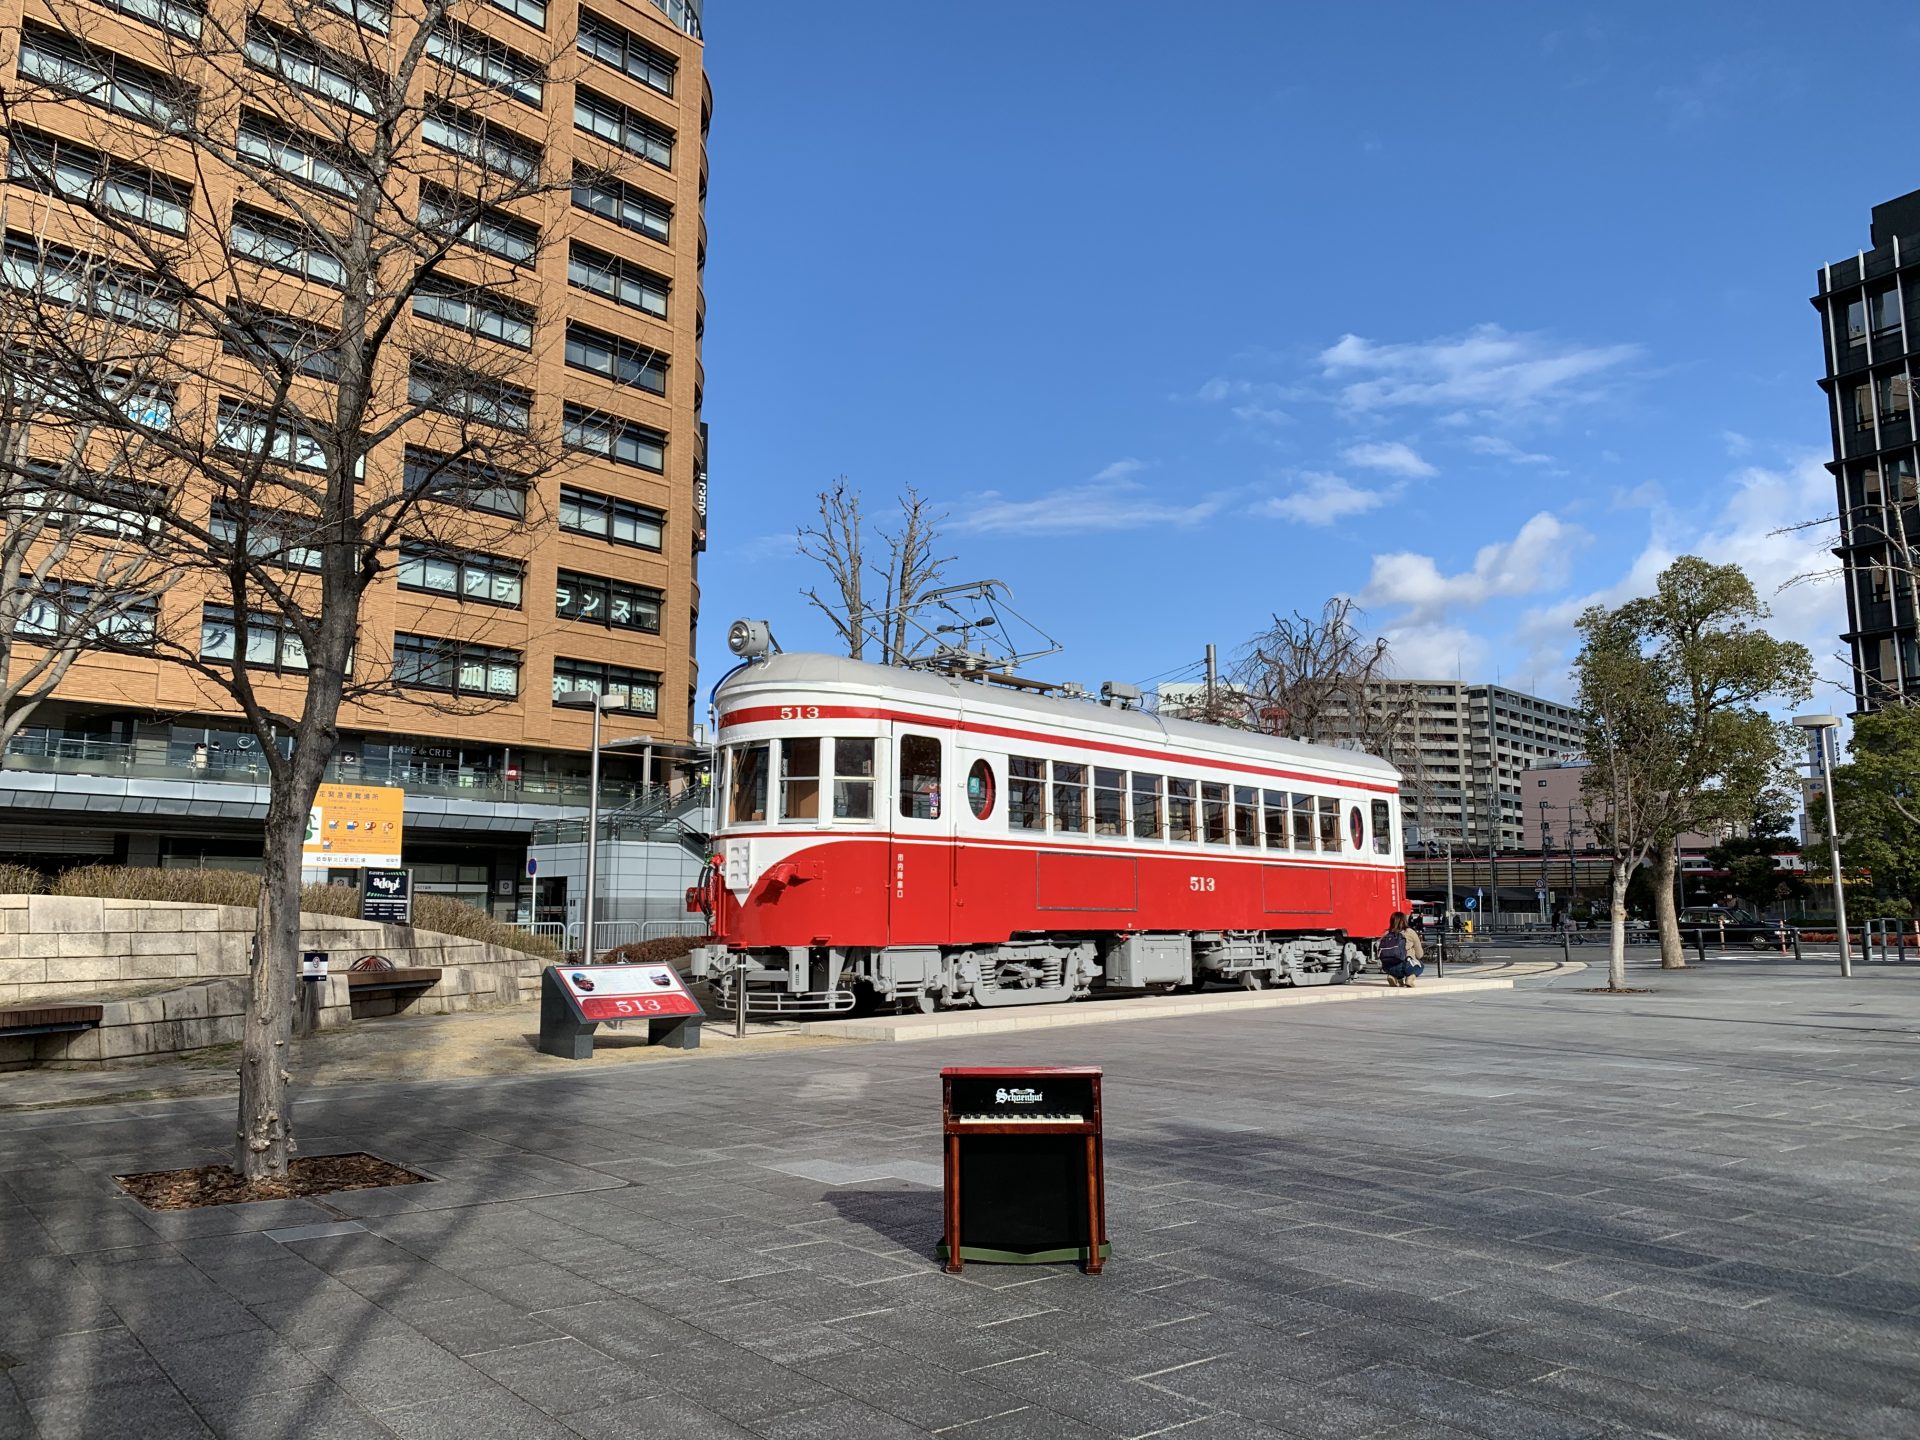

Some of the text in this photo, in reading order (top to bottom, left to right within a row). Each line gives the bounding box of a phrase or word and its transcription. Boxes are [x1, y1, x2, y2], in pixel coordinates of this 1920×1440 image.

[781, 706, 819, 720] 513
[373, 877, 401, 894] adopt
[1190, 876, 1215, 892] 513
[615, 1000, 661, 1013] 513
[995, 1088, 1043, 1104] Schoenhut
